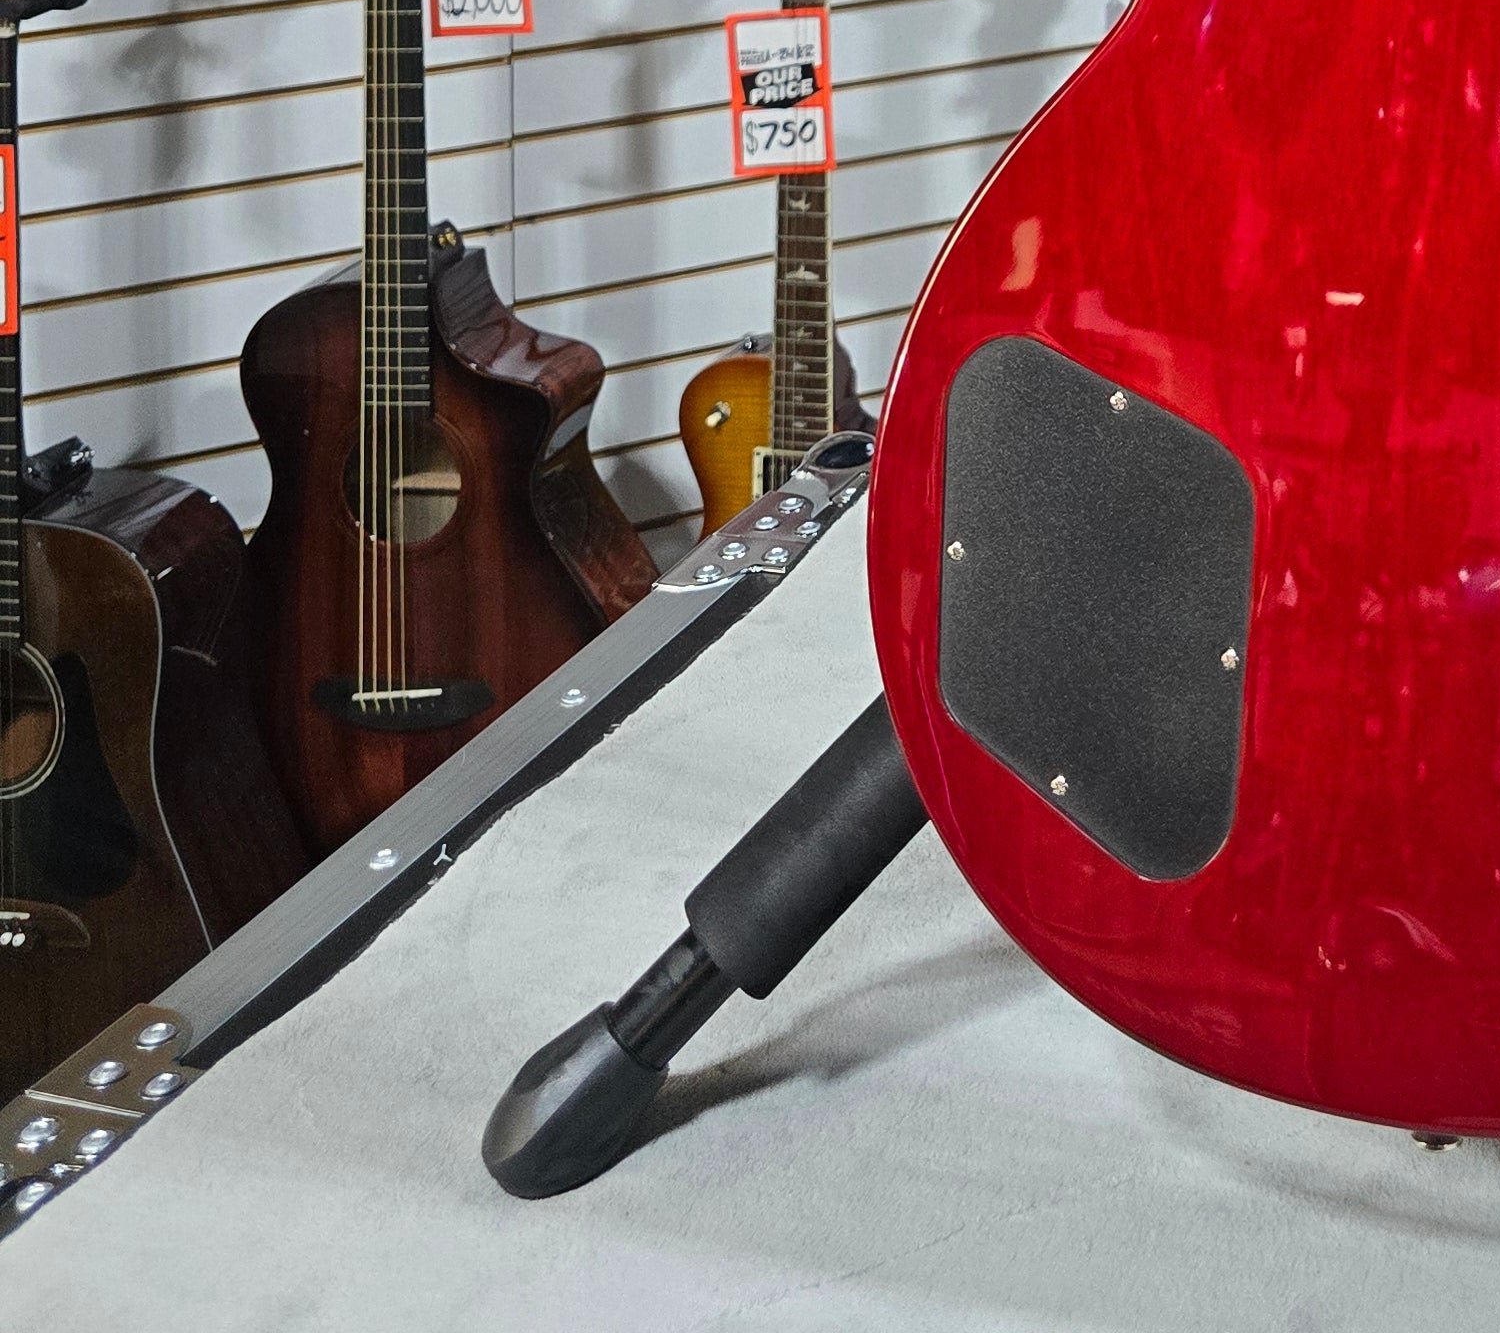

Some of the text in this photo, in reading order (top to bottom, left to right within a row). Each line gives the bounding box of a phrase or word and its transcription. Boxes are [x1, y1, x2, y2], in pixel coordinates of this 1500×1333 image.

[754, 64, 803, 87] OUR
[749, 77, 814, 107] PRICE
[745, 118, 817, 156] $750
